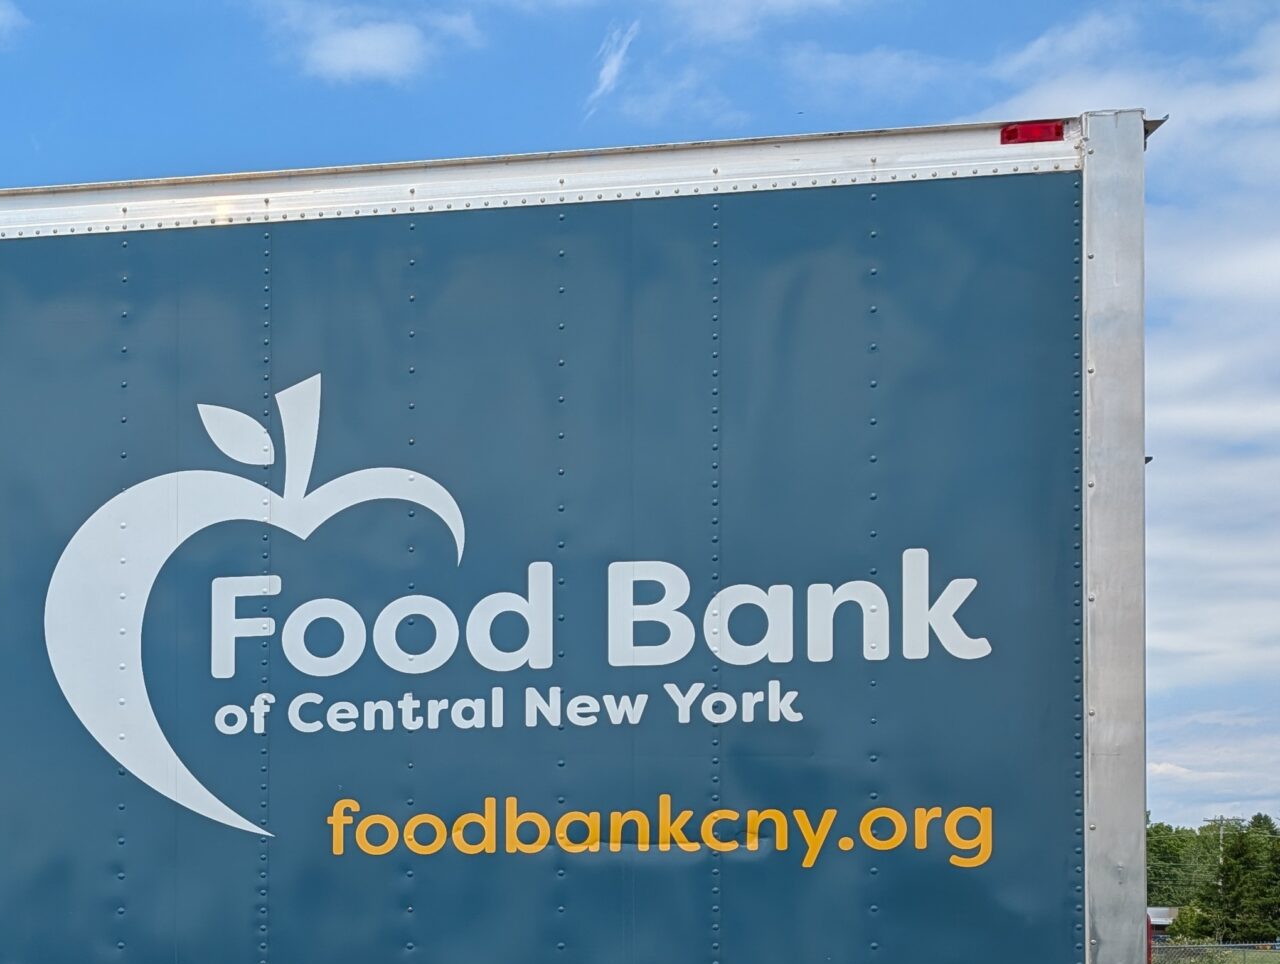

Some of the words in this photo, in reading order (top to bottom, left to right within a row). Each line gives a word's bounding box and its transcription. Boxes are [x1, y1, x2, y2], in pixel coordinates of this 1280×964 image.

[211, 561, 554, 679] Food
[608, 547, 993, 667] Bank
[214, 692, 276, 735] of
[287, 686, 504, 734] Central
[525, 686, 649, 729] New
[663, 679, 804, 725] York
[326, 794, 994, 869] foodbankcny.org
